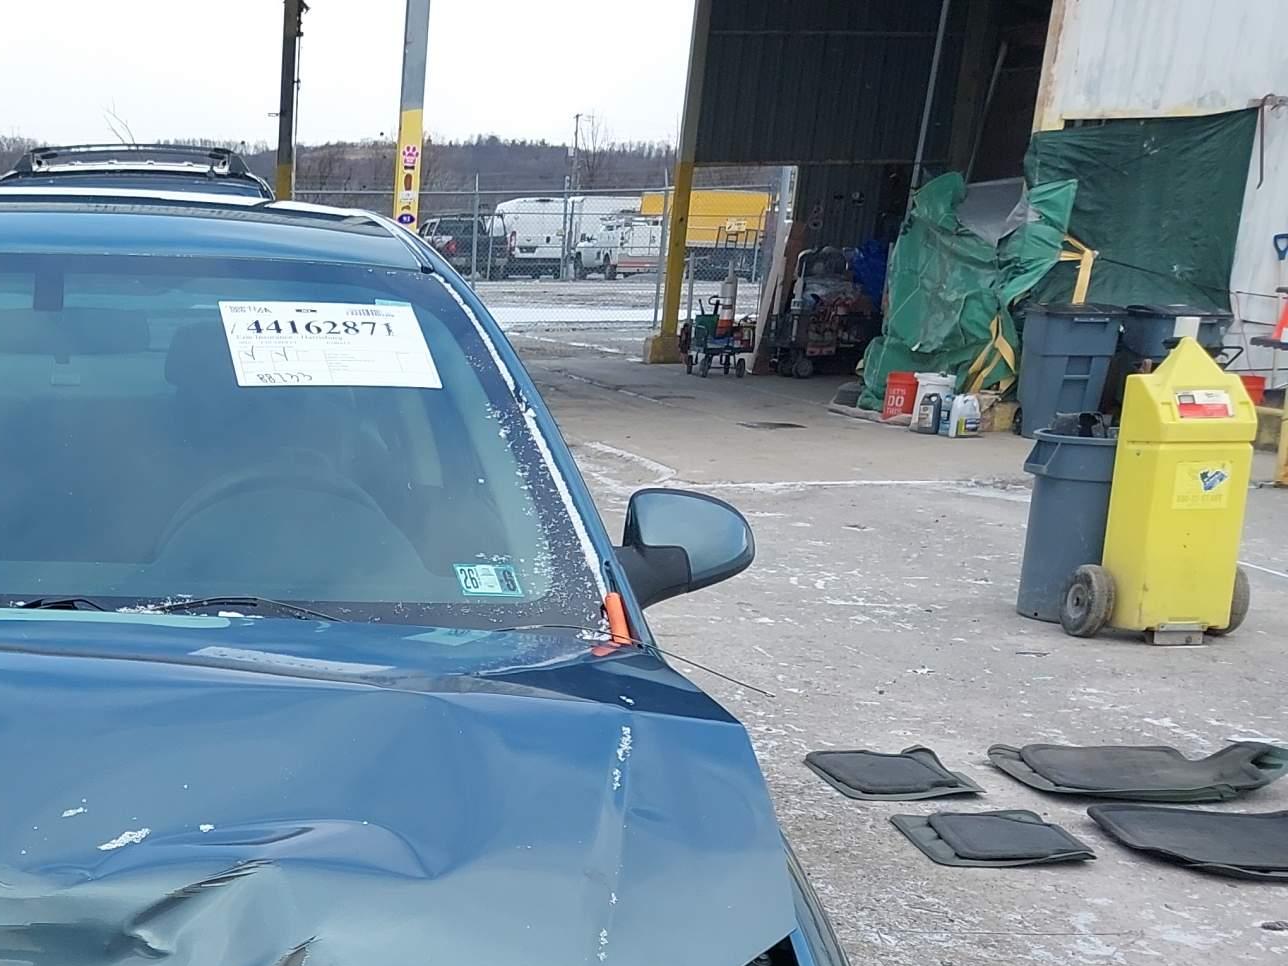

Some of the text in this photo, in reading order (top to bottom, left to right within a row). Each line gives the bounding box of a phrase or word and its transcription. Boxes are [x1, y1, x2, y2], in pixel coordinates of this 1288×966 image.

[247, 319, 394, 337] 44162871
[887, 395, 905, 407] DO
[459, 568, 479, 589] 26
